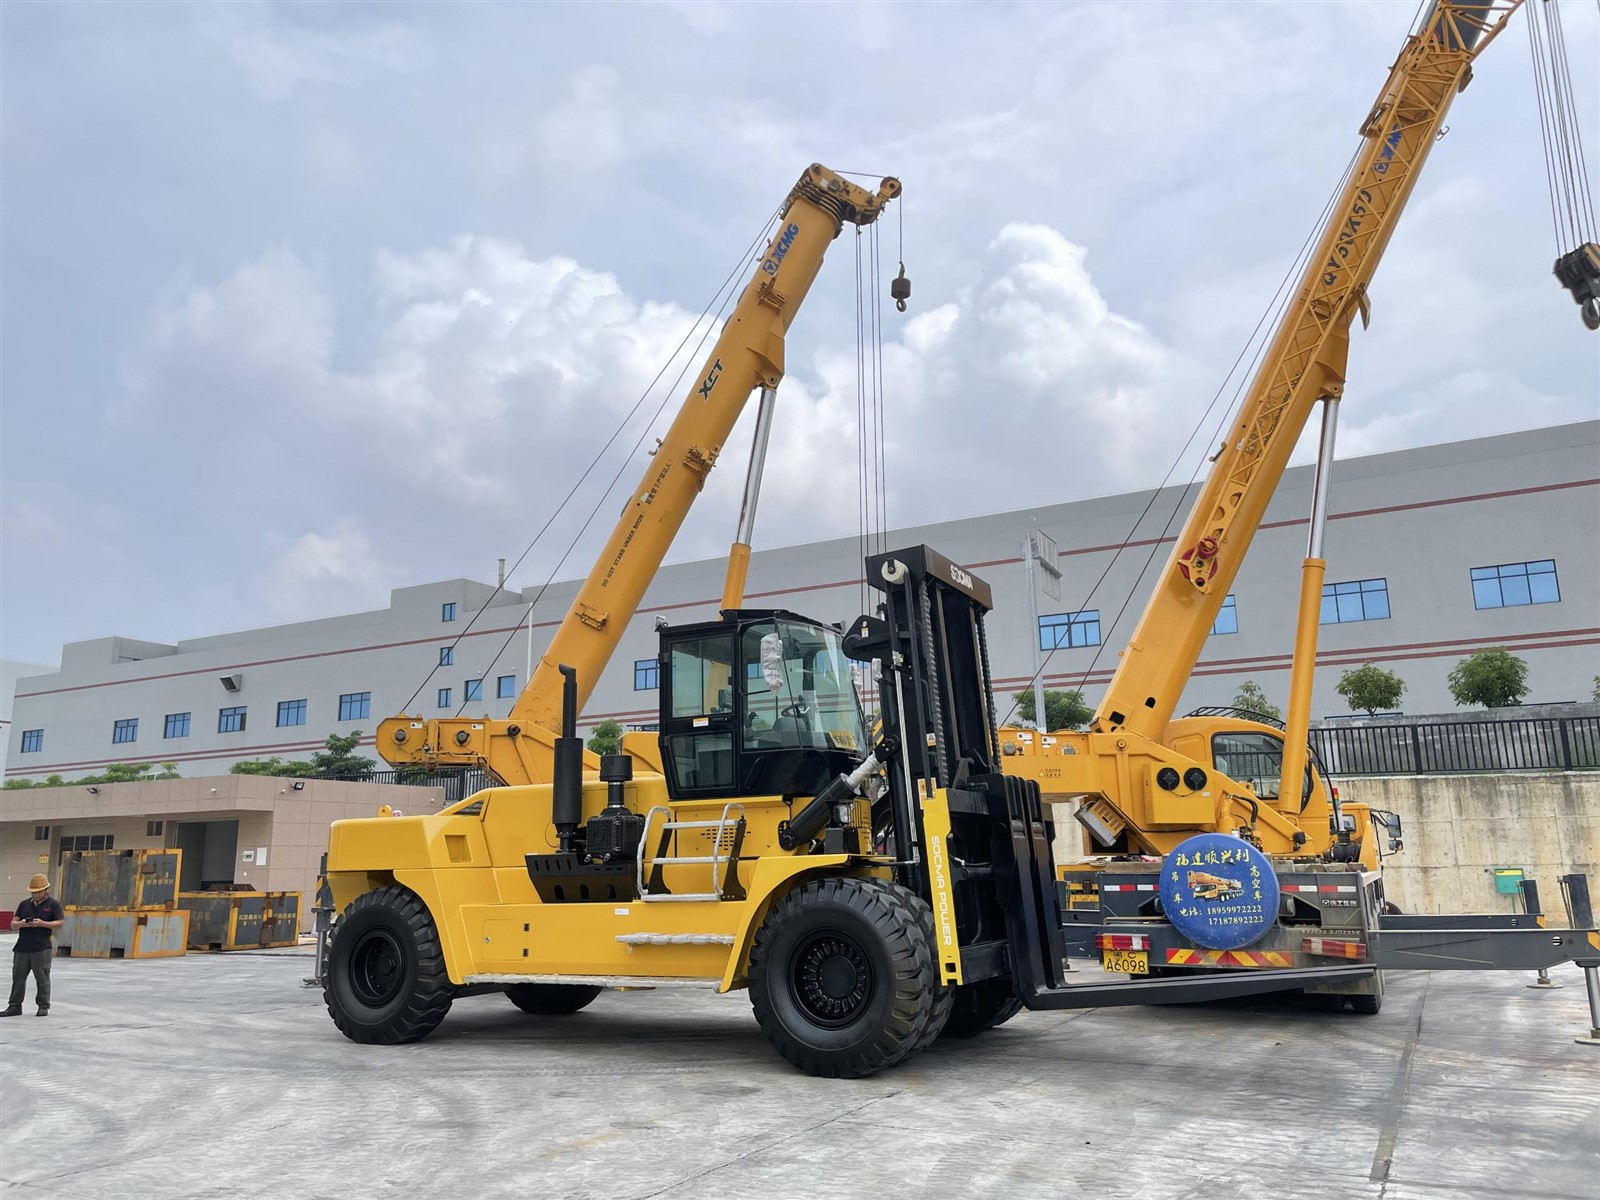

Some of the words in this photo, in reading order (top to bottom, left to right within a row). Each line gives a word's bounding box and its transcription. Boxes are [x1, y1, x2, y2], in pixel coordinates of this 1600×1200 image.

[771, 223, 799, 263] XCMG
[606, 566, 616, 579] NOT
[613, 548, 626, 566] STAND
[623, 529, 636, 548] UNDER
[931, 835, 946, 889] SOCMA
[1175, 848, 1250, 866] 福建顺兴利
[938, 892, 952, 946] POWER
[1207, 905, 1262, 915] 18959972222
[1208, 915, 1264, 926] 17187892222
[1106, 958, 1146, 973] A6098
